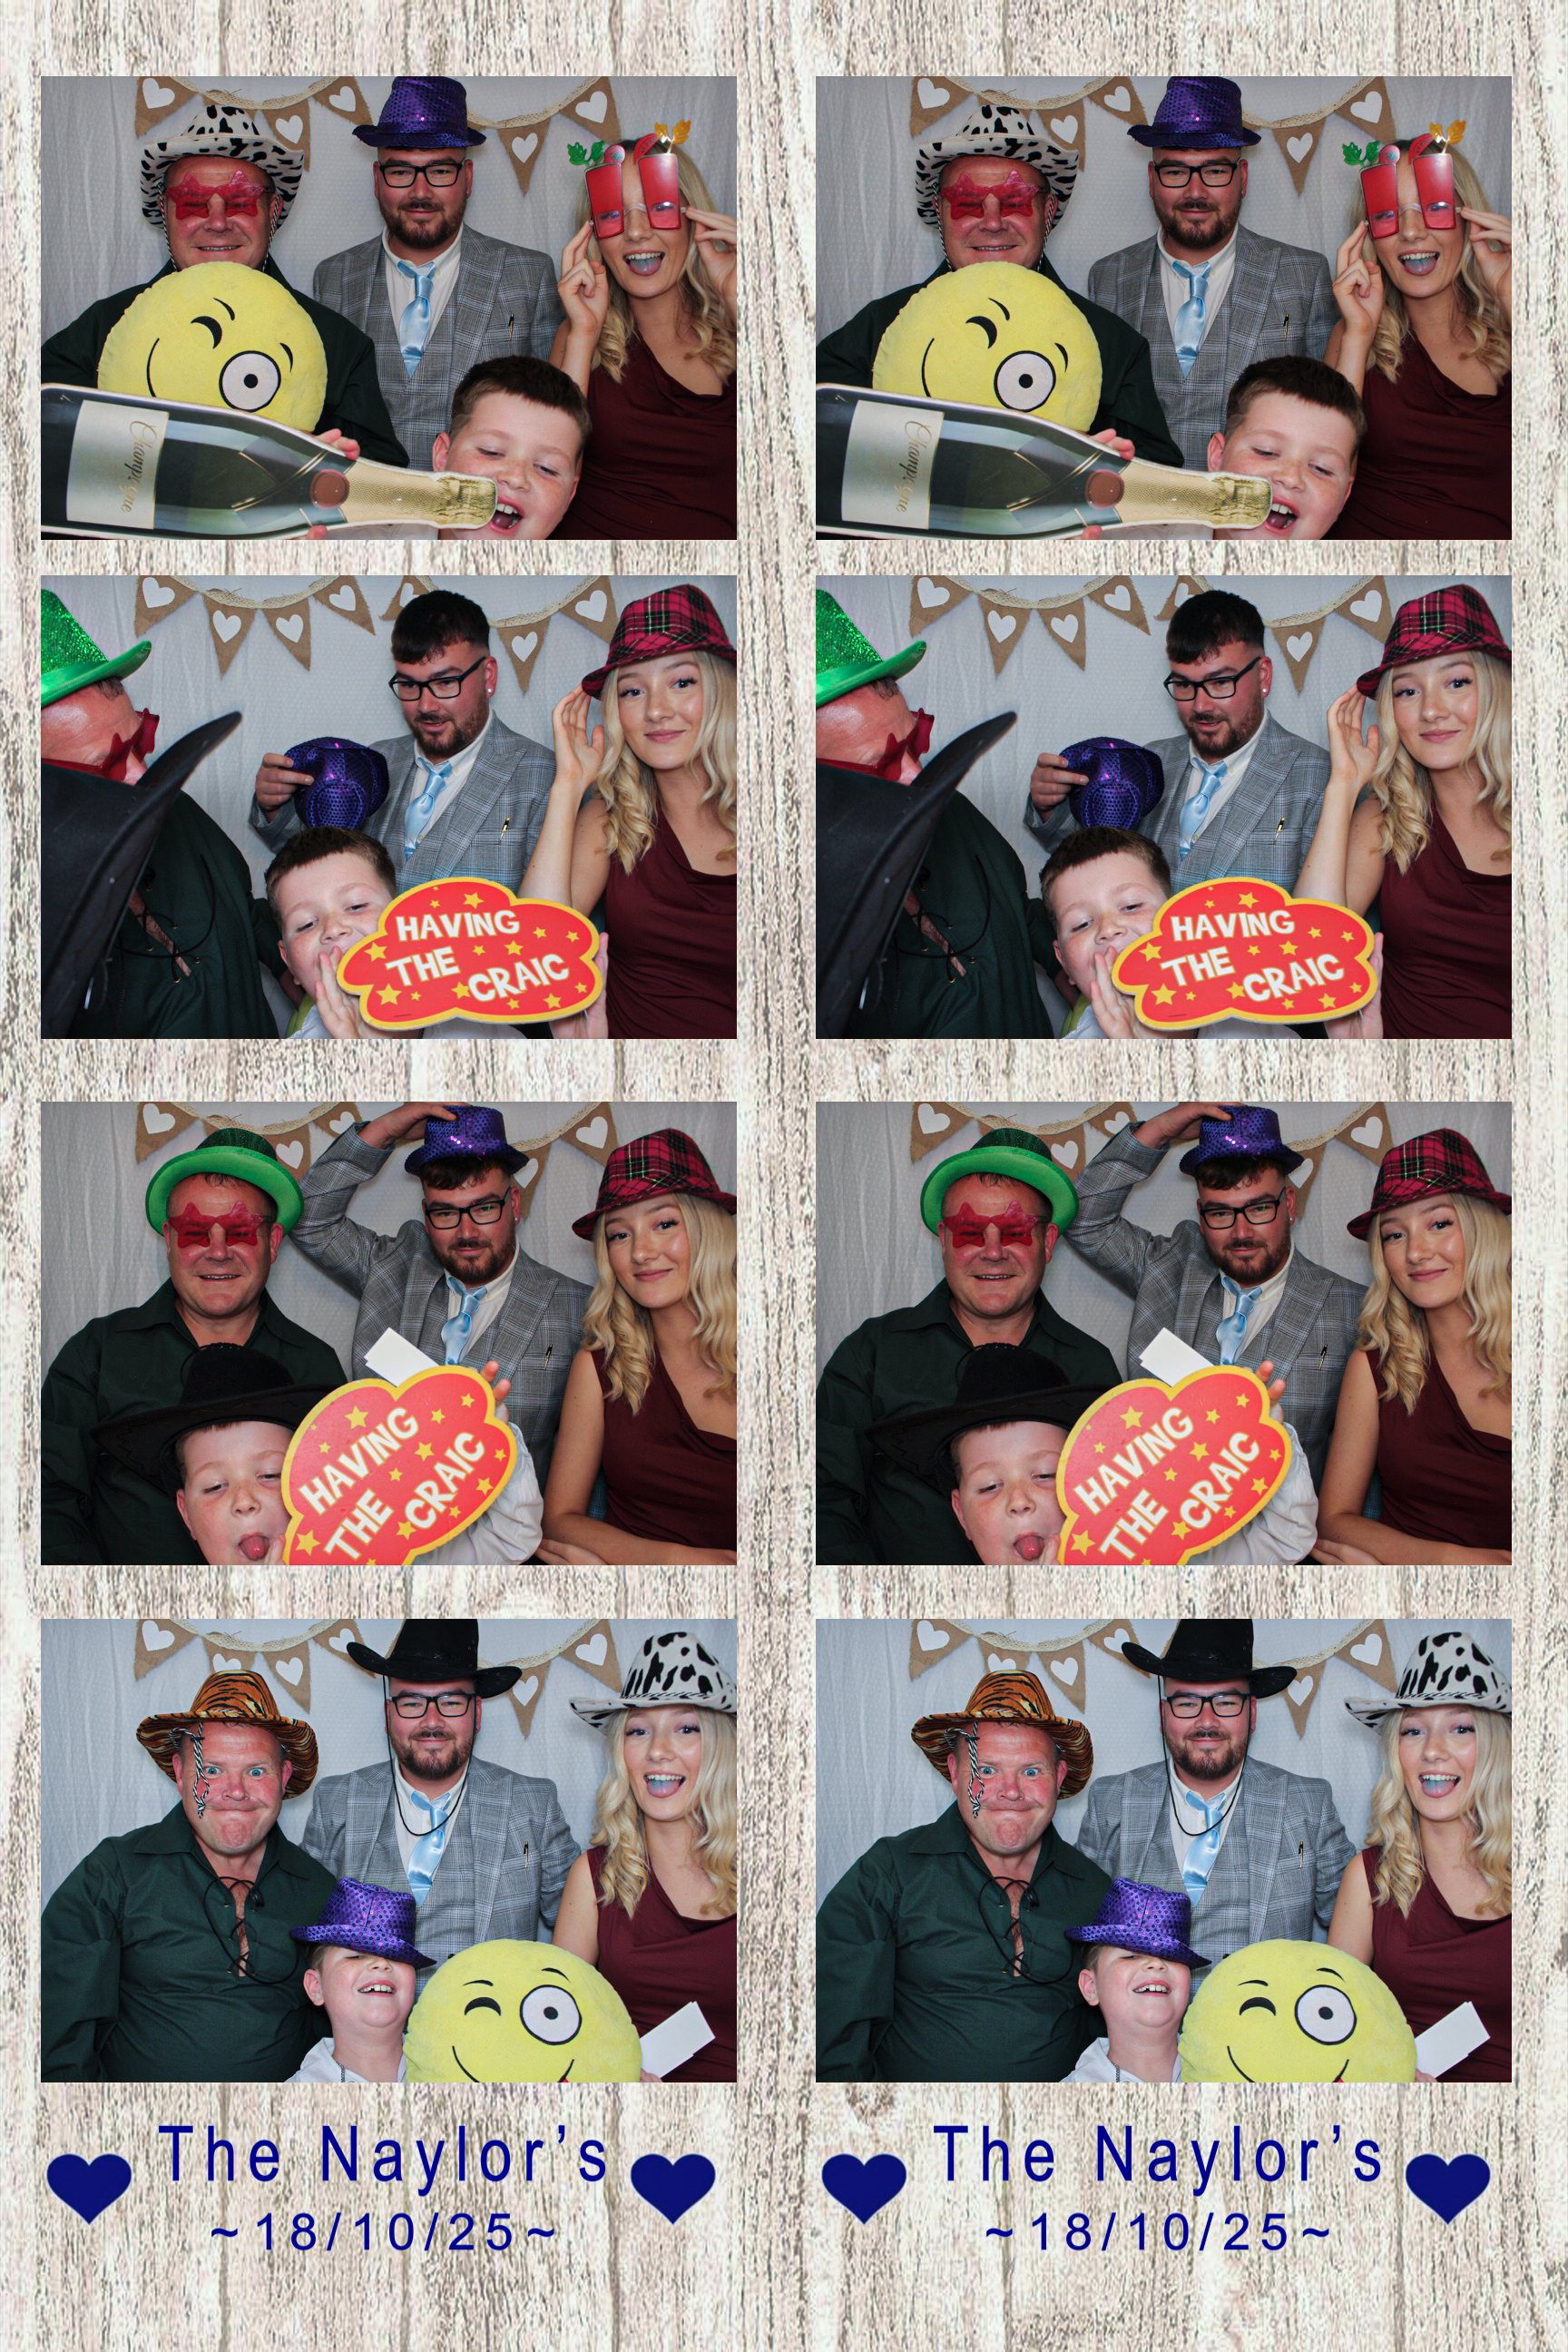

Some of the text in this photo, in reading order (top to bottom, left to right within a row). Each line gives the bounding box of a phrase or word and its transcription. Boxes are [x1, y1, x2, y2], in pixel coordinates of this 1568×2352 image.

[119, 420, 157, 513] Champagne
[894, 420, 932, 513] Champagne
[396, 909, 521, 942] HAVING
[1171, 909, 1296, 942] HAVING
[385, 946, 461, 987] THE
[467, 953, 570, 1003] CRAIC
[1160, 946, 1236, 987] THE
[1242, 953, 1345, 1003] CRAIC
[298, 1406, 420, 1515] HAVING
[405, 1432, 485, 1530] CRAIC
[1073, 1406, 1195, 1515] HAVING
[1180, 1432, 1260, 1530] CRAIC
[323, 1488, 394, 1561] THE
[1098, 1488, 1169, 1561] THE
